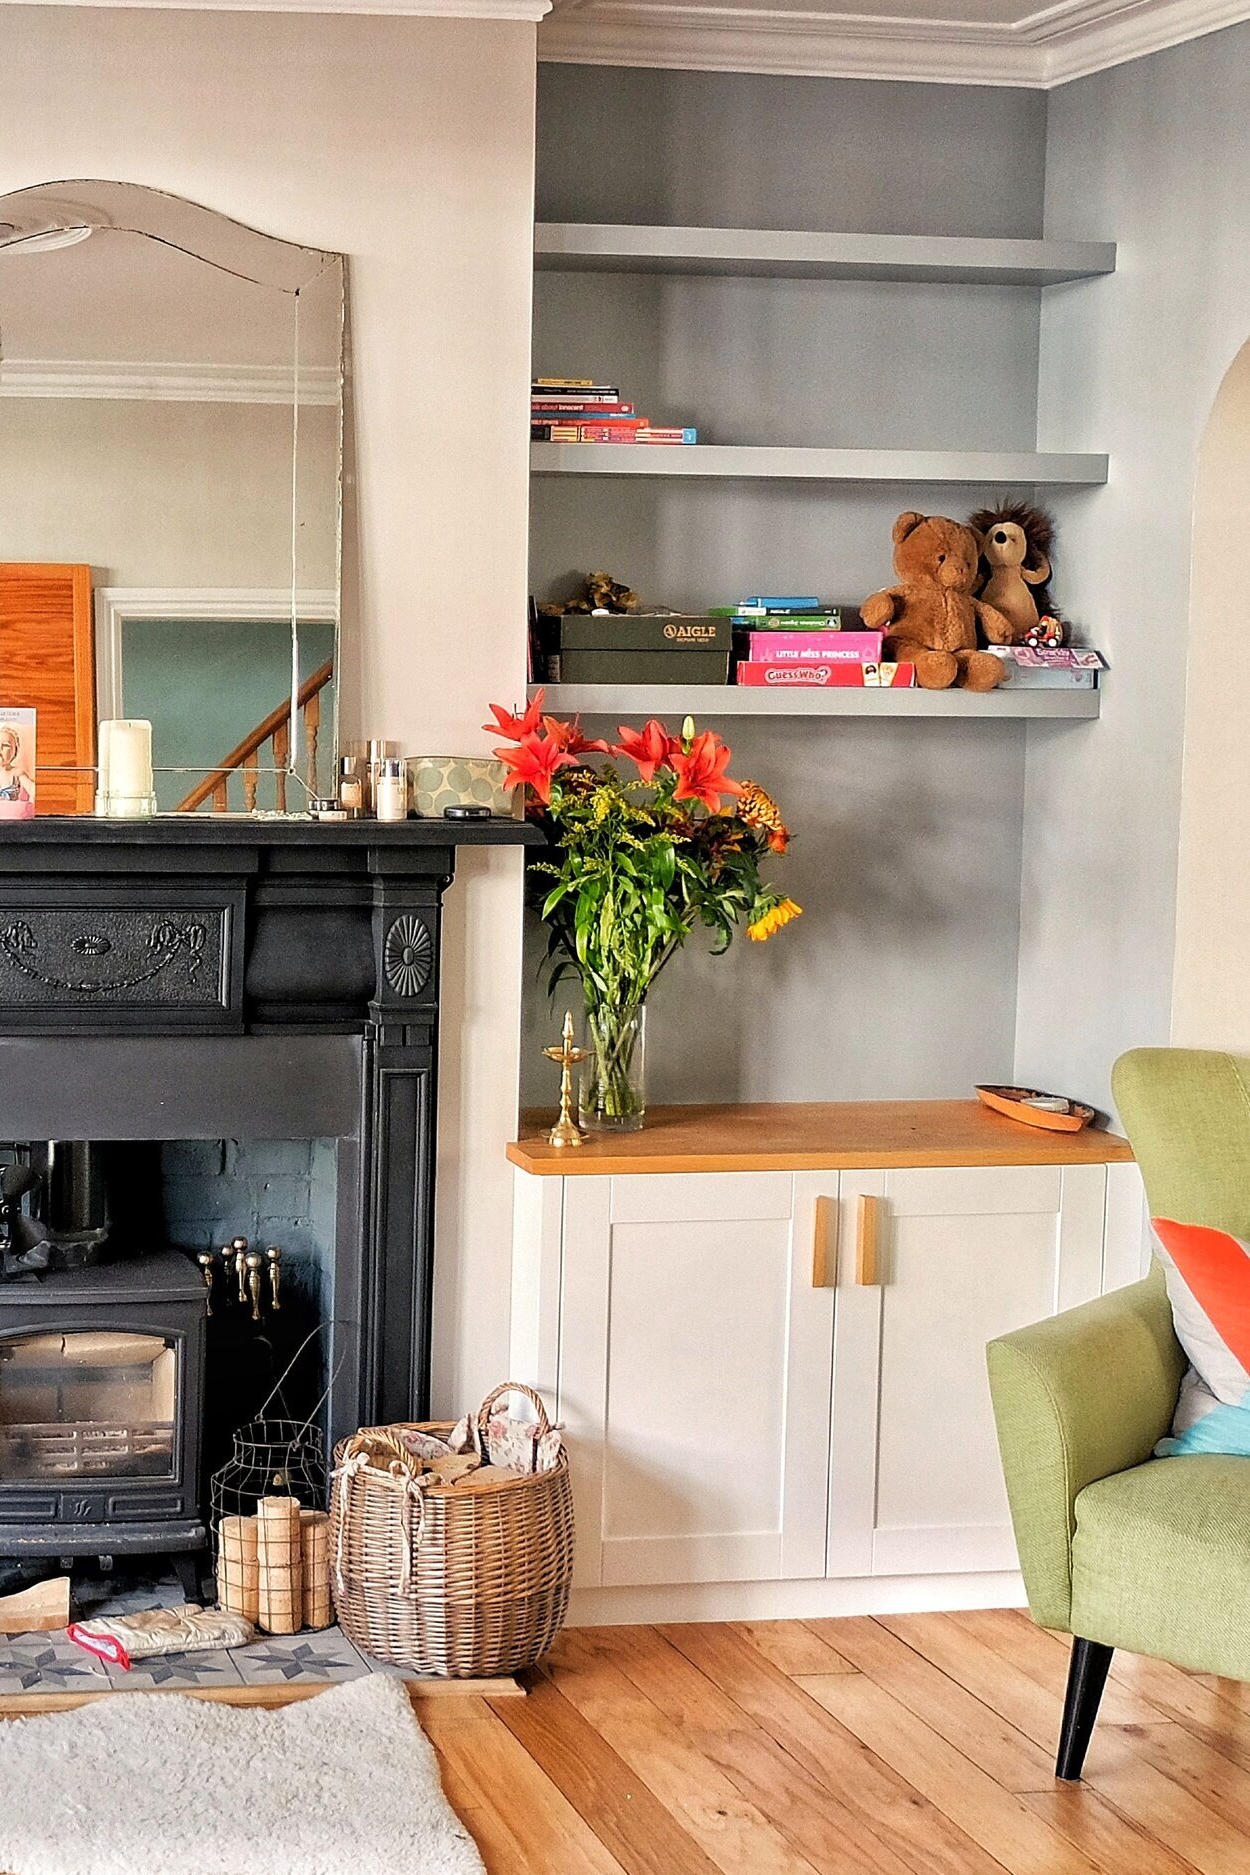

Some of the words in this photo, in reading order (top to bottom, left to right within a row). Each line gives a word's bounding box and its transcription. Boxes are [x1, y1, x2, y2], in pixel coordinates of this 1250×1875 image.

[676, 627, 716, 637] AIGLE
[776, 651, 798, 659] LITTLE
[800, 648, 820, 659] MISS
[822, 651, 860, 659] PRINCESS
[767, 671, 798, 680] Guess
[798, 669, 828, 682] Who?
